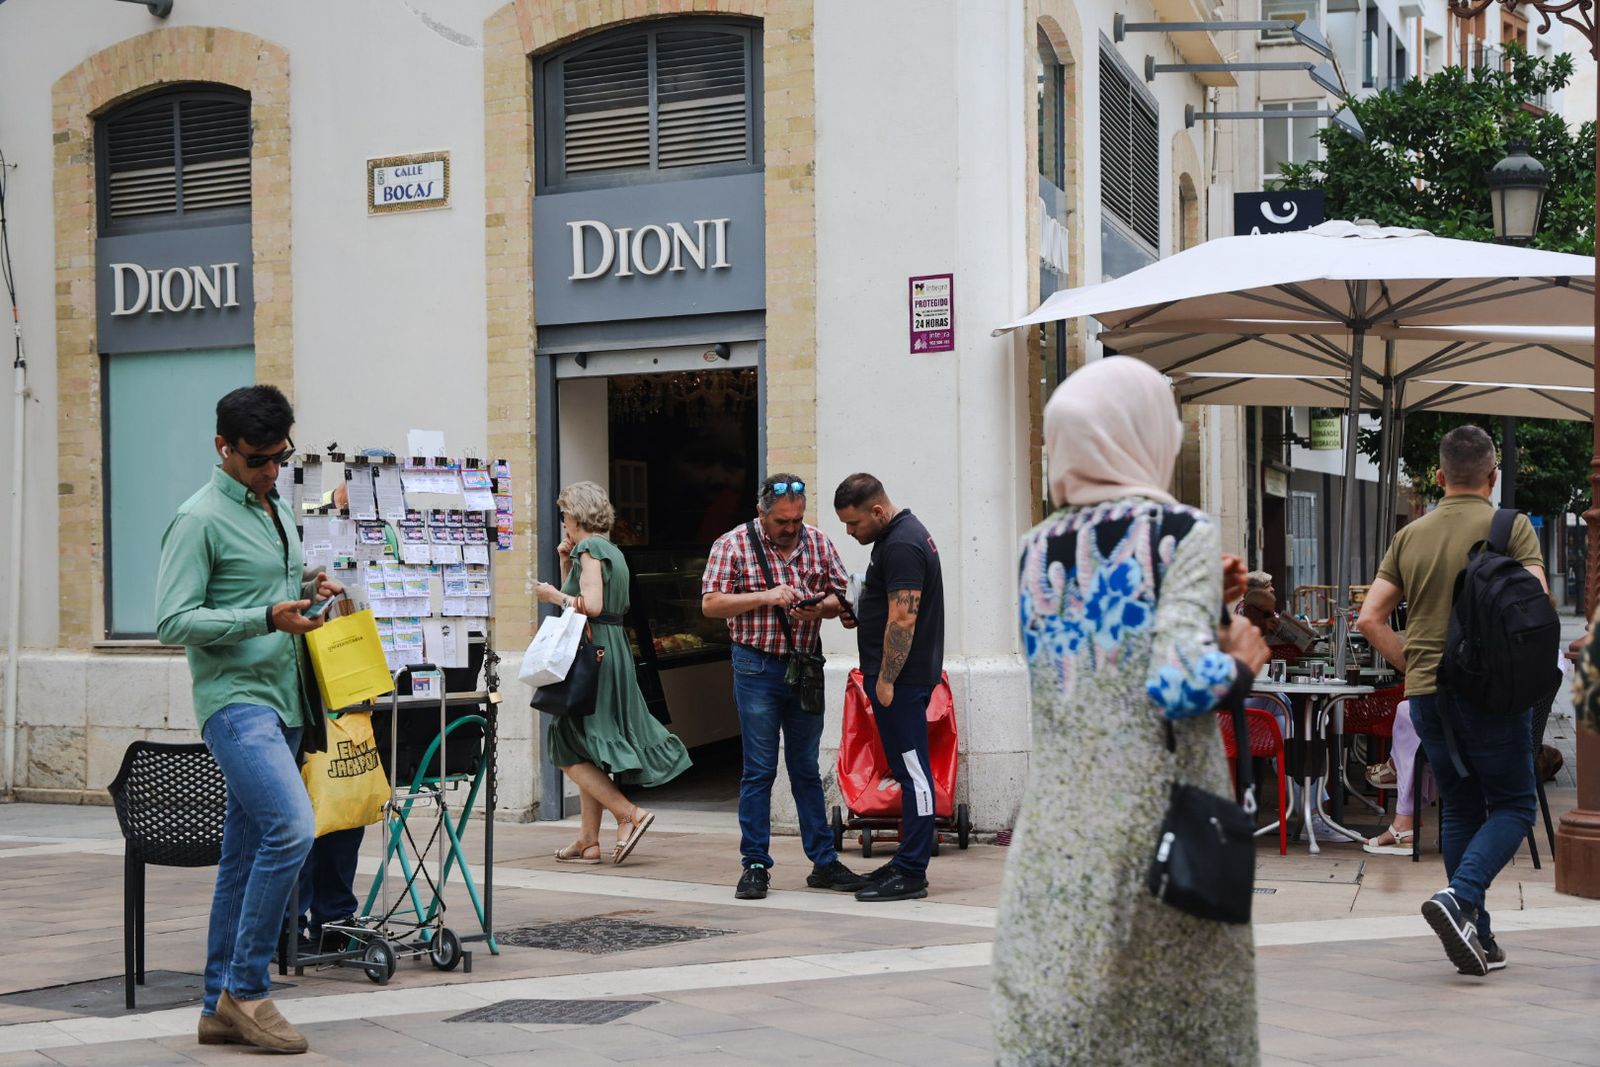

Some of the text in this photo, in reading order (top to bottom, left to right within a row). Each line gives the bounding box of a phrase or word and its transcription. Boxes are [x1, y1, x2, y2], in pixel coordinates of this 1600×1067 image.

[394, 165, 424, 178] CALLE
[383, 181, 434, 202] BOCAS
[566, 217, 732, 281] DIONI
[109, 262, 241, 316] DIONI
[915, 298, 948, 308] PROTEGIDO
[915, 317, 949, 329] 24 HORAS
